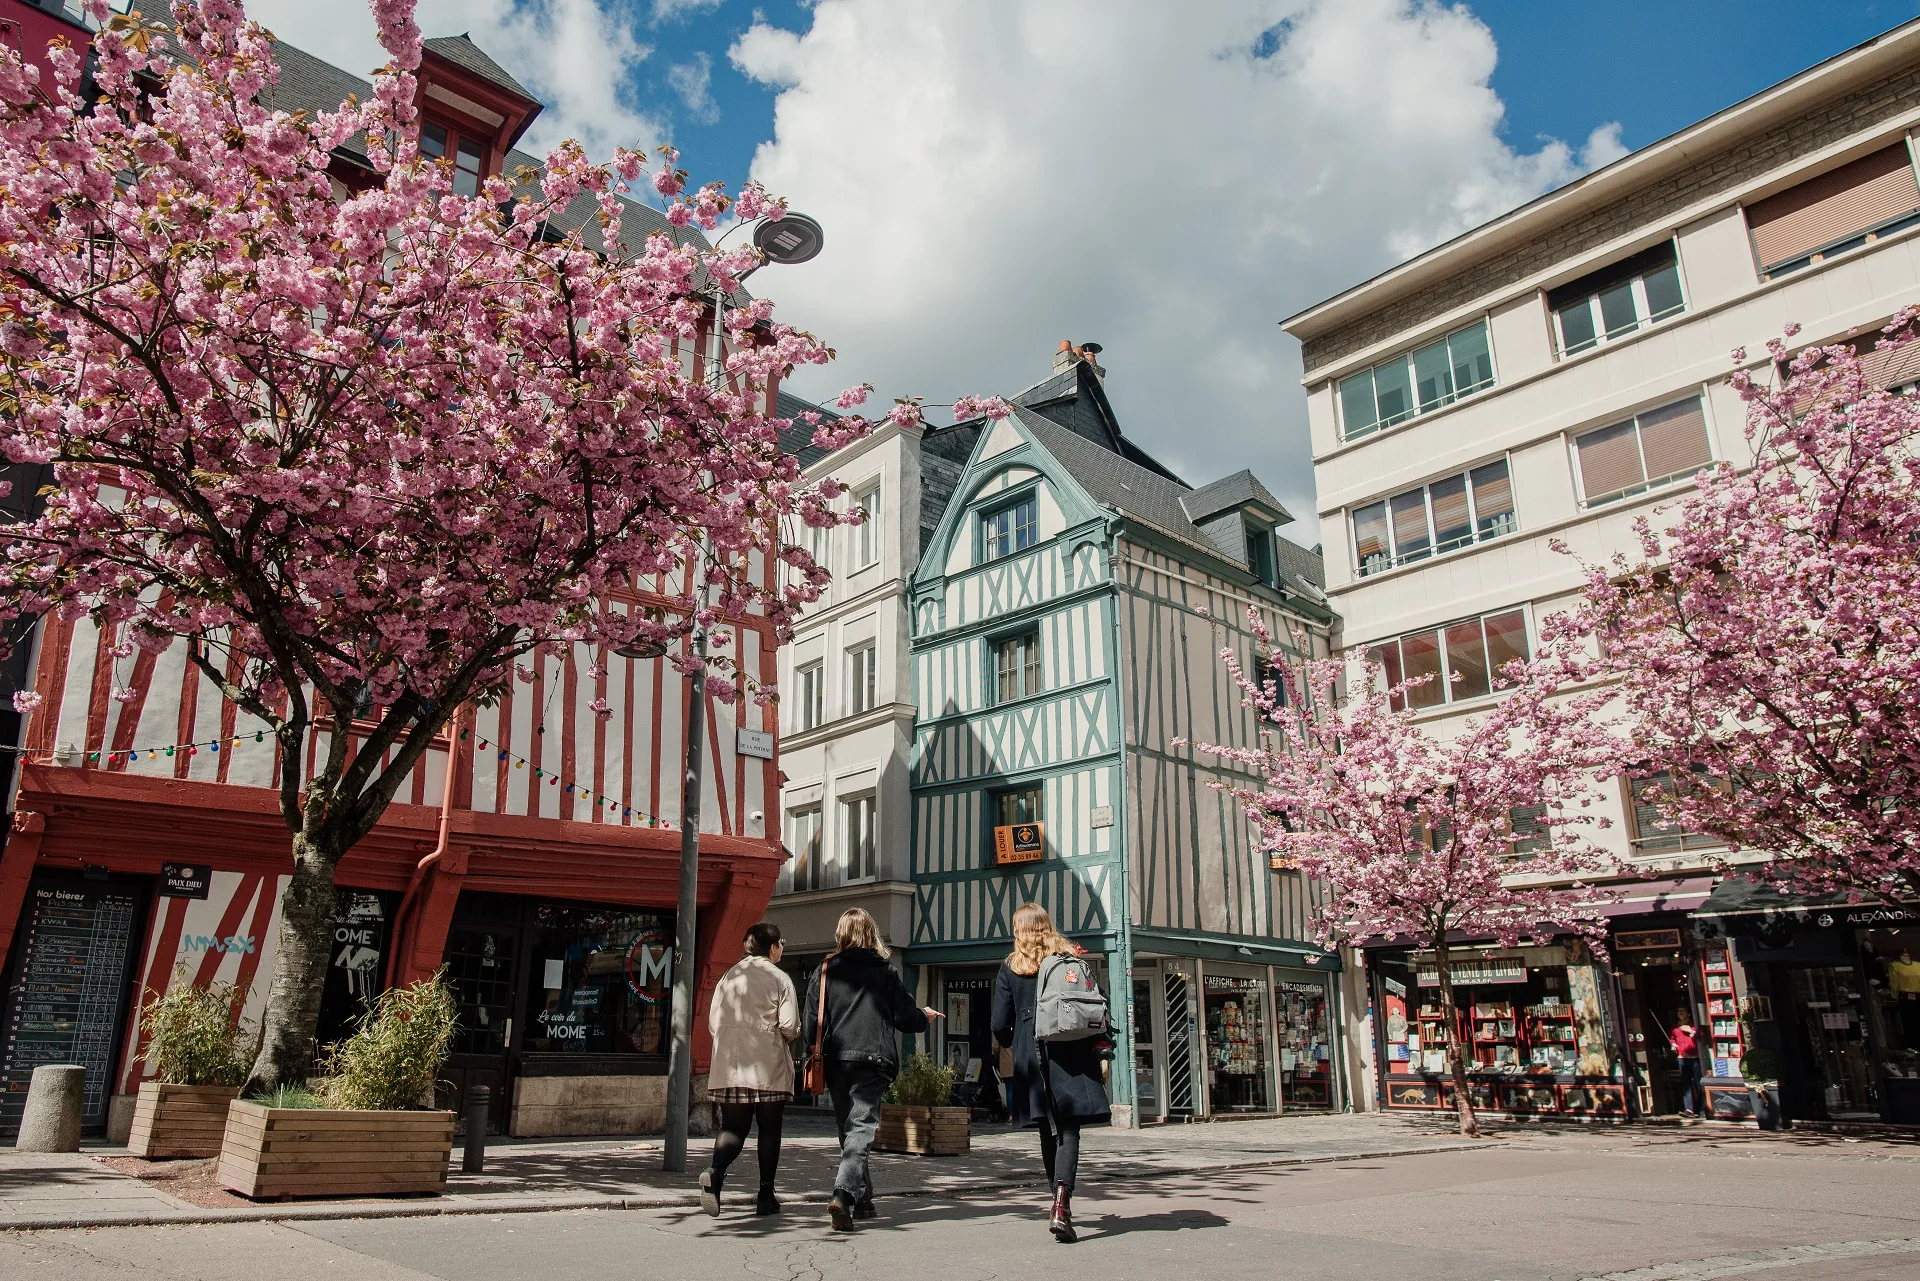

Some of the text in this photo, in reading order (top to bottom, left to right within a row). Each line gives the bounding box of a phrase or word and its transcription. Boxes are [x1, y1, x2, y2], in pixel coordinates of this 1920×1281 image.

[168, 879, 202, 888] PAIX DIEU
[37, 890, 53, 898] Nos
[335, 928, 374, 944] OME
[640, 944, 672, 988] M
[1421, 960, 1520, 980] ACHA T VENTE DE LIVRES
[945, 980, 989, 988] 'AFFICHE
[1204, 976, 1233, 986] L'AFFICHE
[1240, 979, 1248, 987] LA
[536, 1010, 549, 1023] Le
[566, 1011, 576, 1021] du
